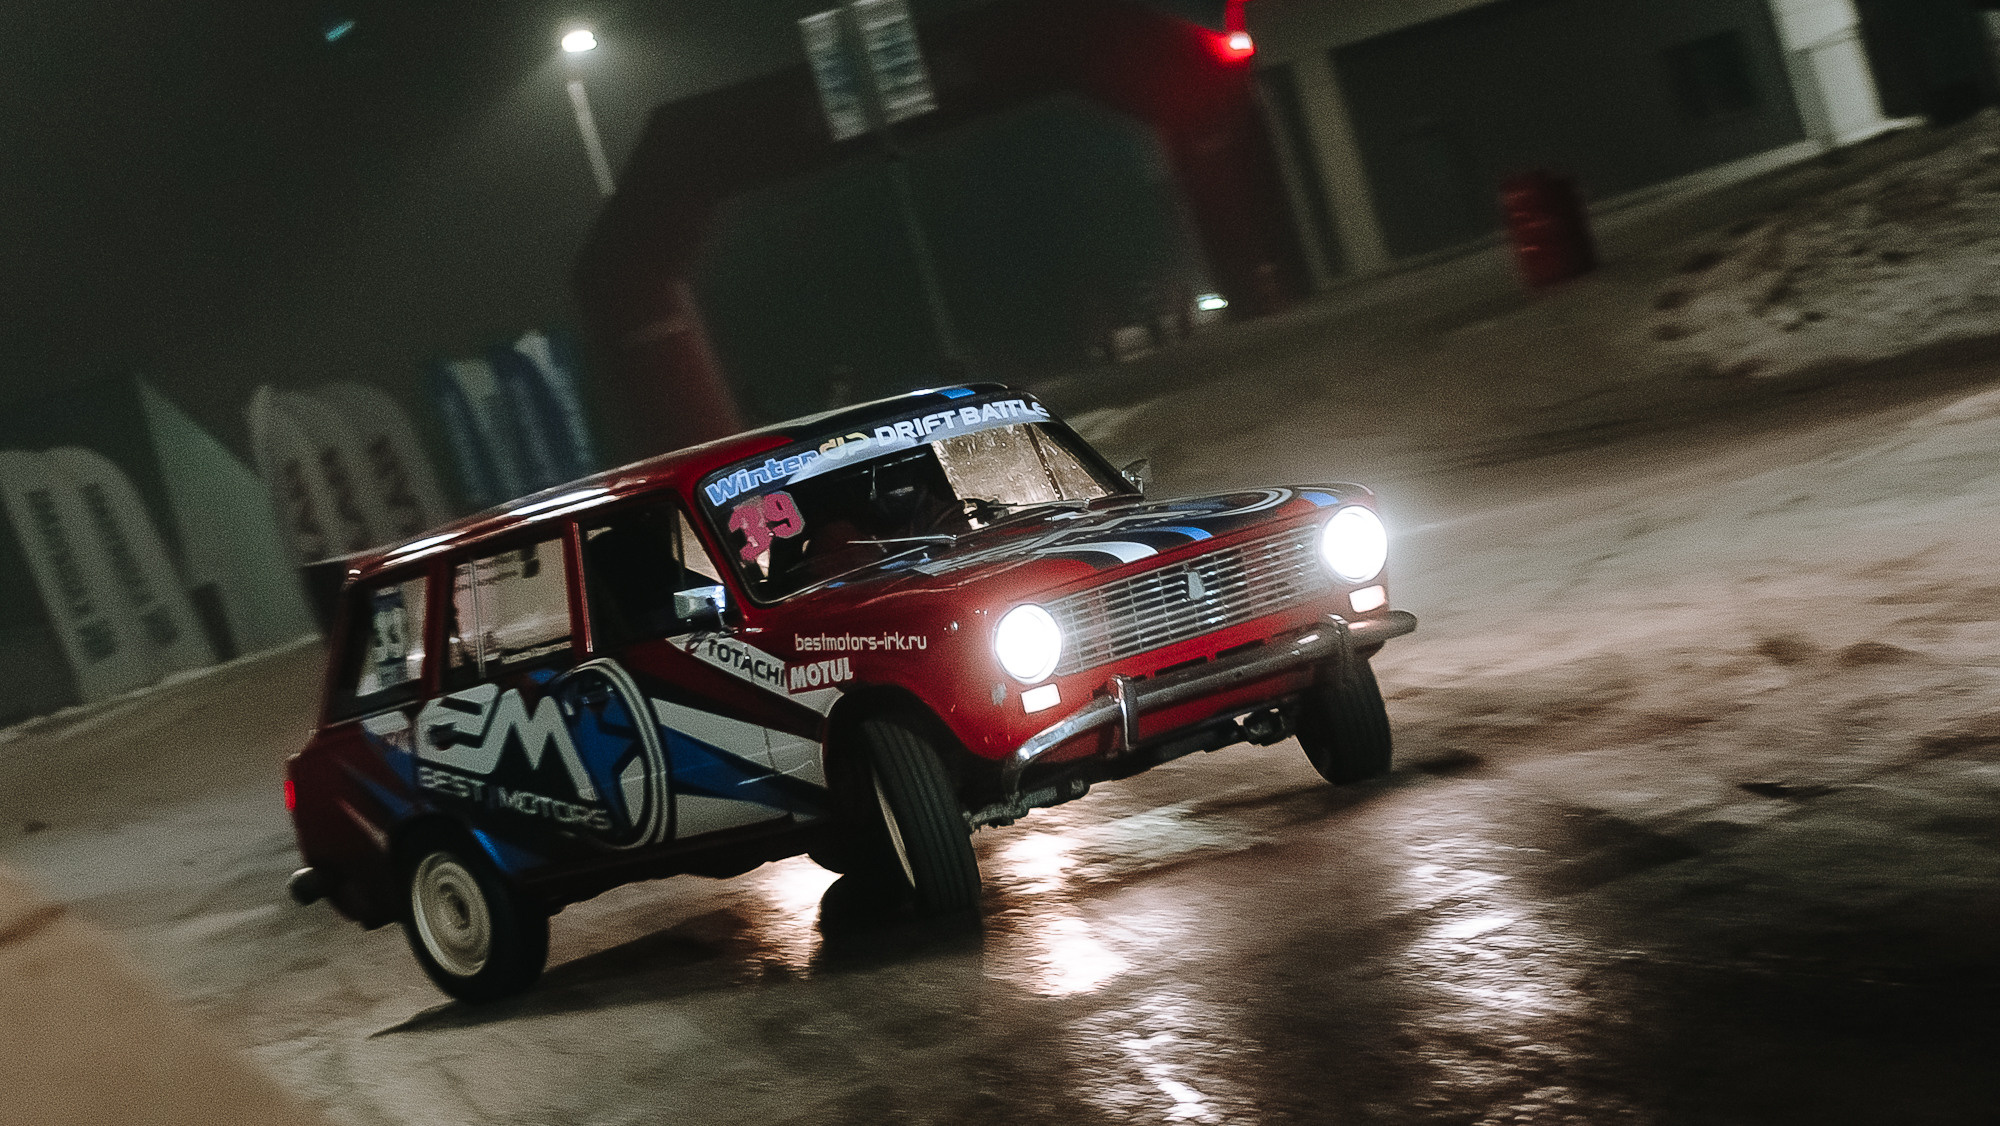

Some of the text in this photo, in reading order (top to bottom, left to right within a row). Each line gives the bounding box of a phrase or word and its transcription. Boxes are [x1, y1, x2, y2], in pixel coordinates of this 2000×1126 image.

[704, 450, 820, 506] Winter
[874, 410, 956, 448] DRIFT
[958, 398, 1051, 427] BATTLE
[707, 638, 786, 688] TOTACHI
[795, 631, 928, 651] bestmotors-irk.ru
[790, 656, 854, 691] MOTUL
[497, 785, 614, 831] MOTORS
